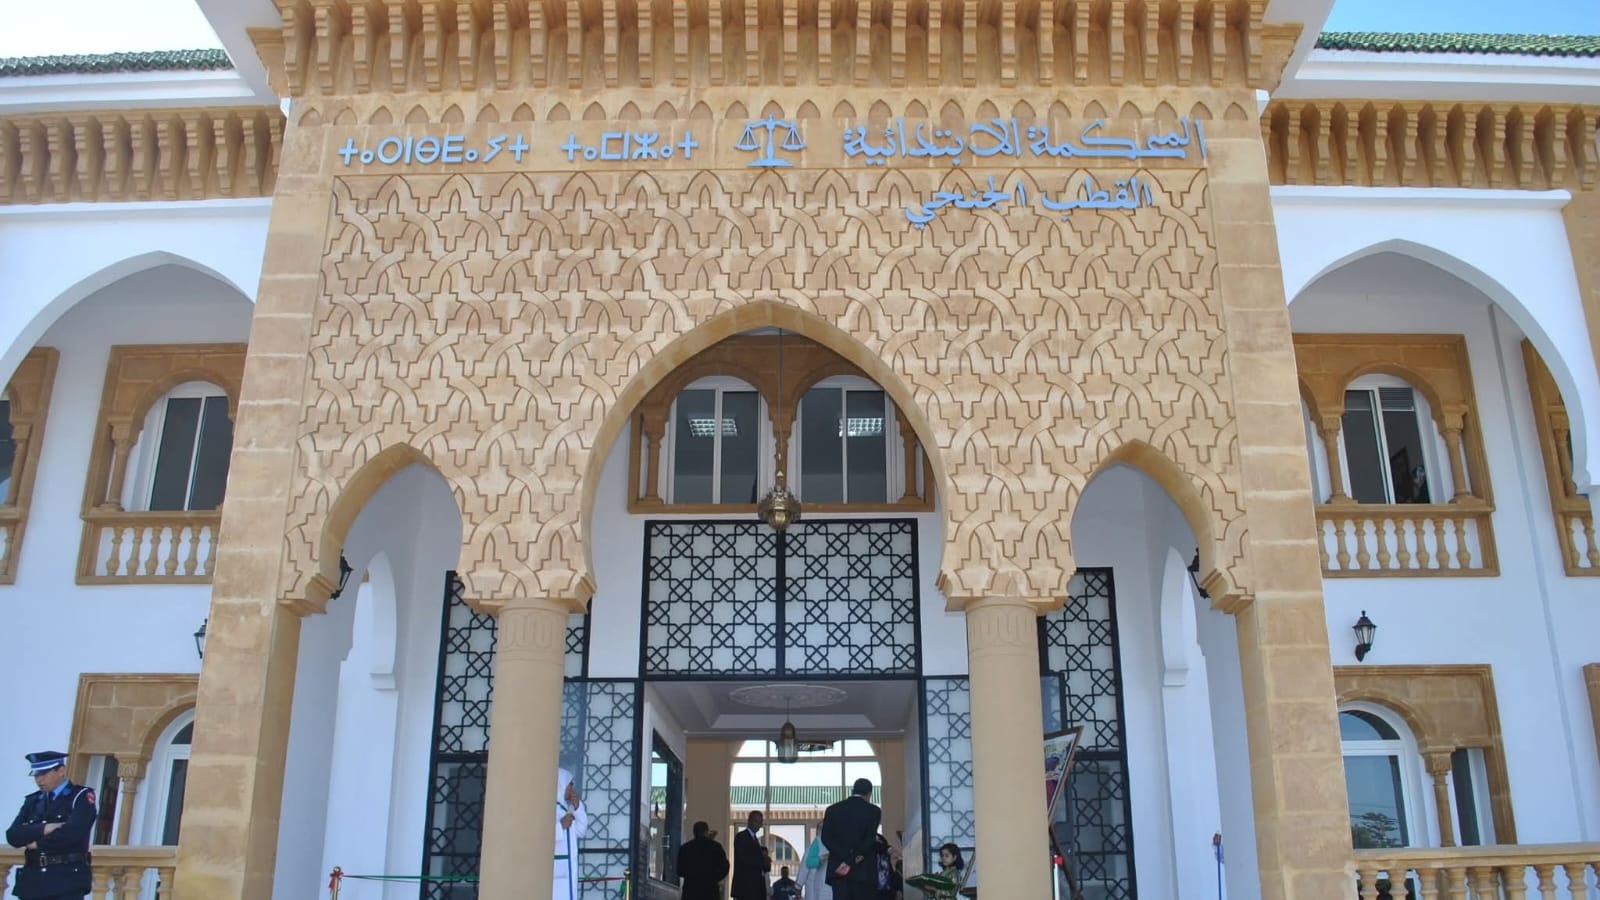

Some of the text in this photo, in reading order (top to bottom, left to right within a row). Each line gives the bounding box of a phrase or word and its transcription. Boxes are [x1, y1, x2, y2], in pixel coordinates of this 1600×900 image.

[843, 115, 1207, 166] المحكمة الابتدائية
[904, 175, 1154, 230] القطب الجنحي
